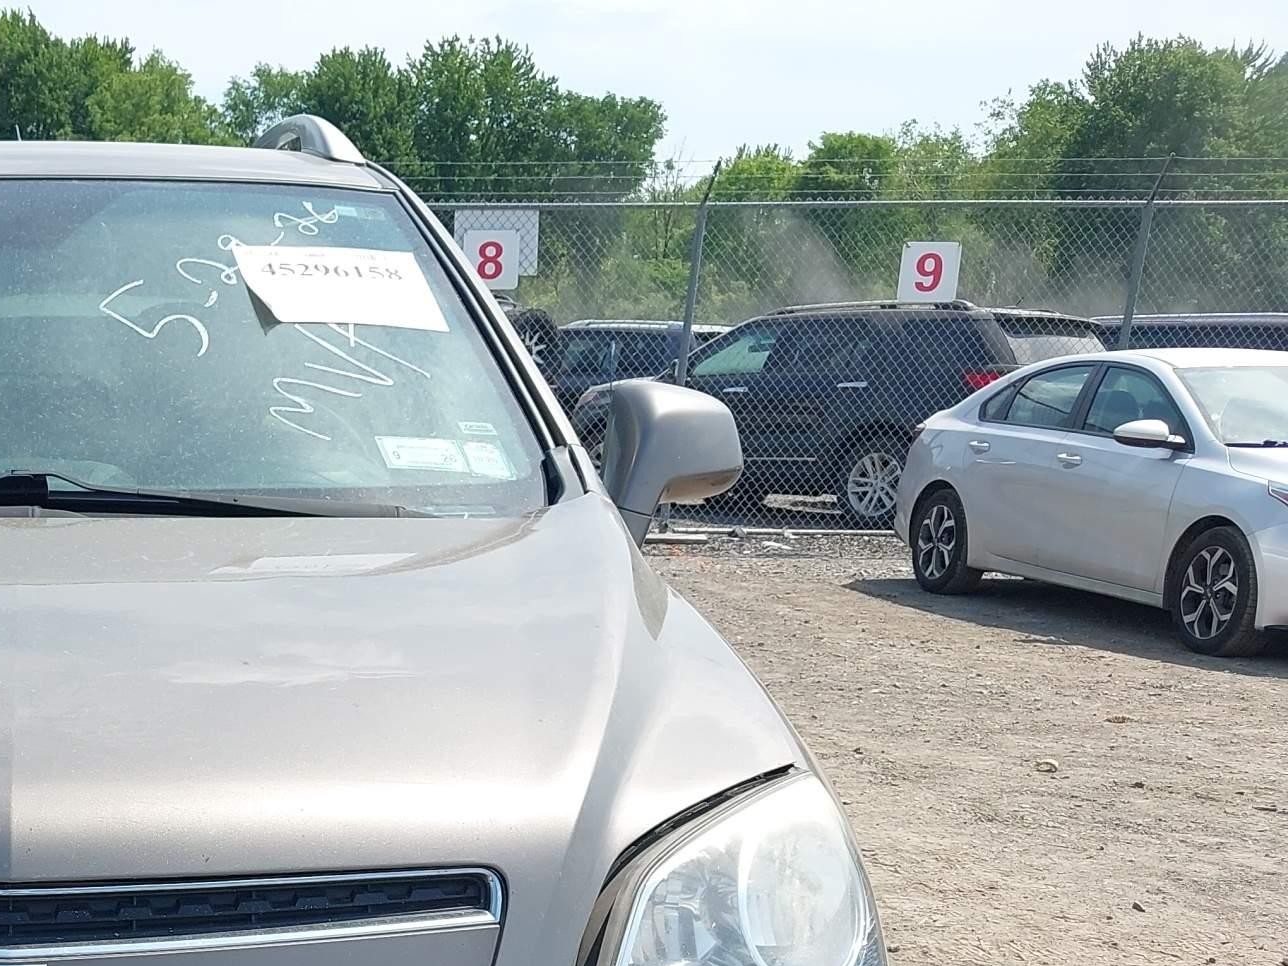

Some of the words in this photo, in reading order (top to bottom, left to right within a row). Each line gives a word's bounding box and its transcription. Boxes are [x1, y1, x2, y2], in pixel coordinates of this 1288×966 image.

[262, 262, 403, 281] 45296158
[477, 241, 503, 280] 8
[914, 252, 943, 292] 9
